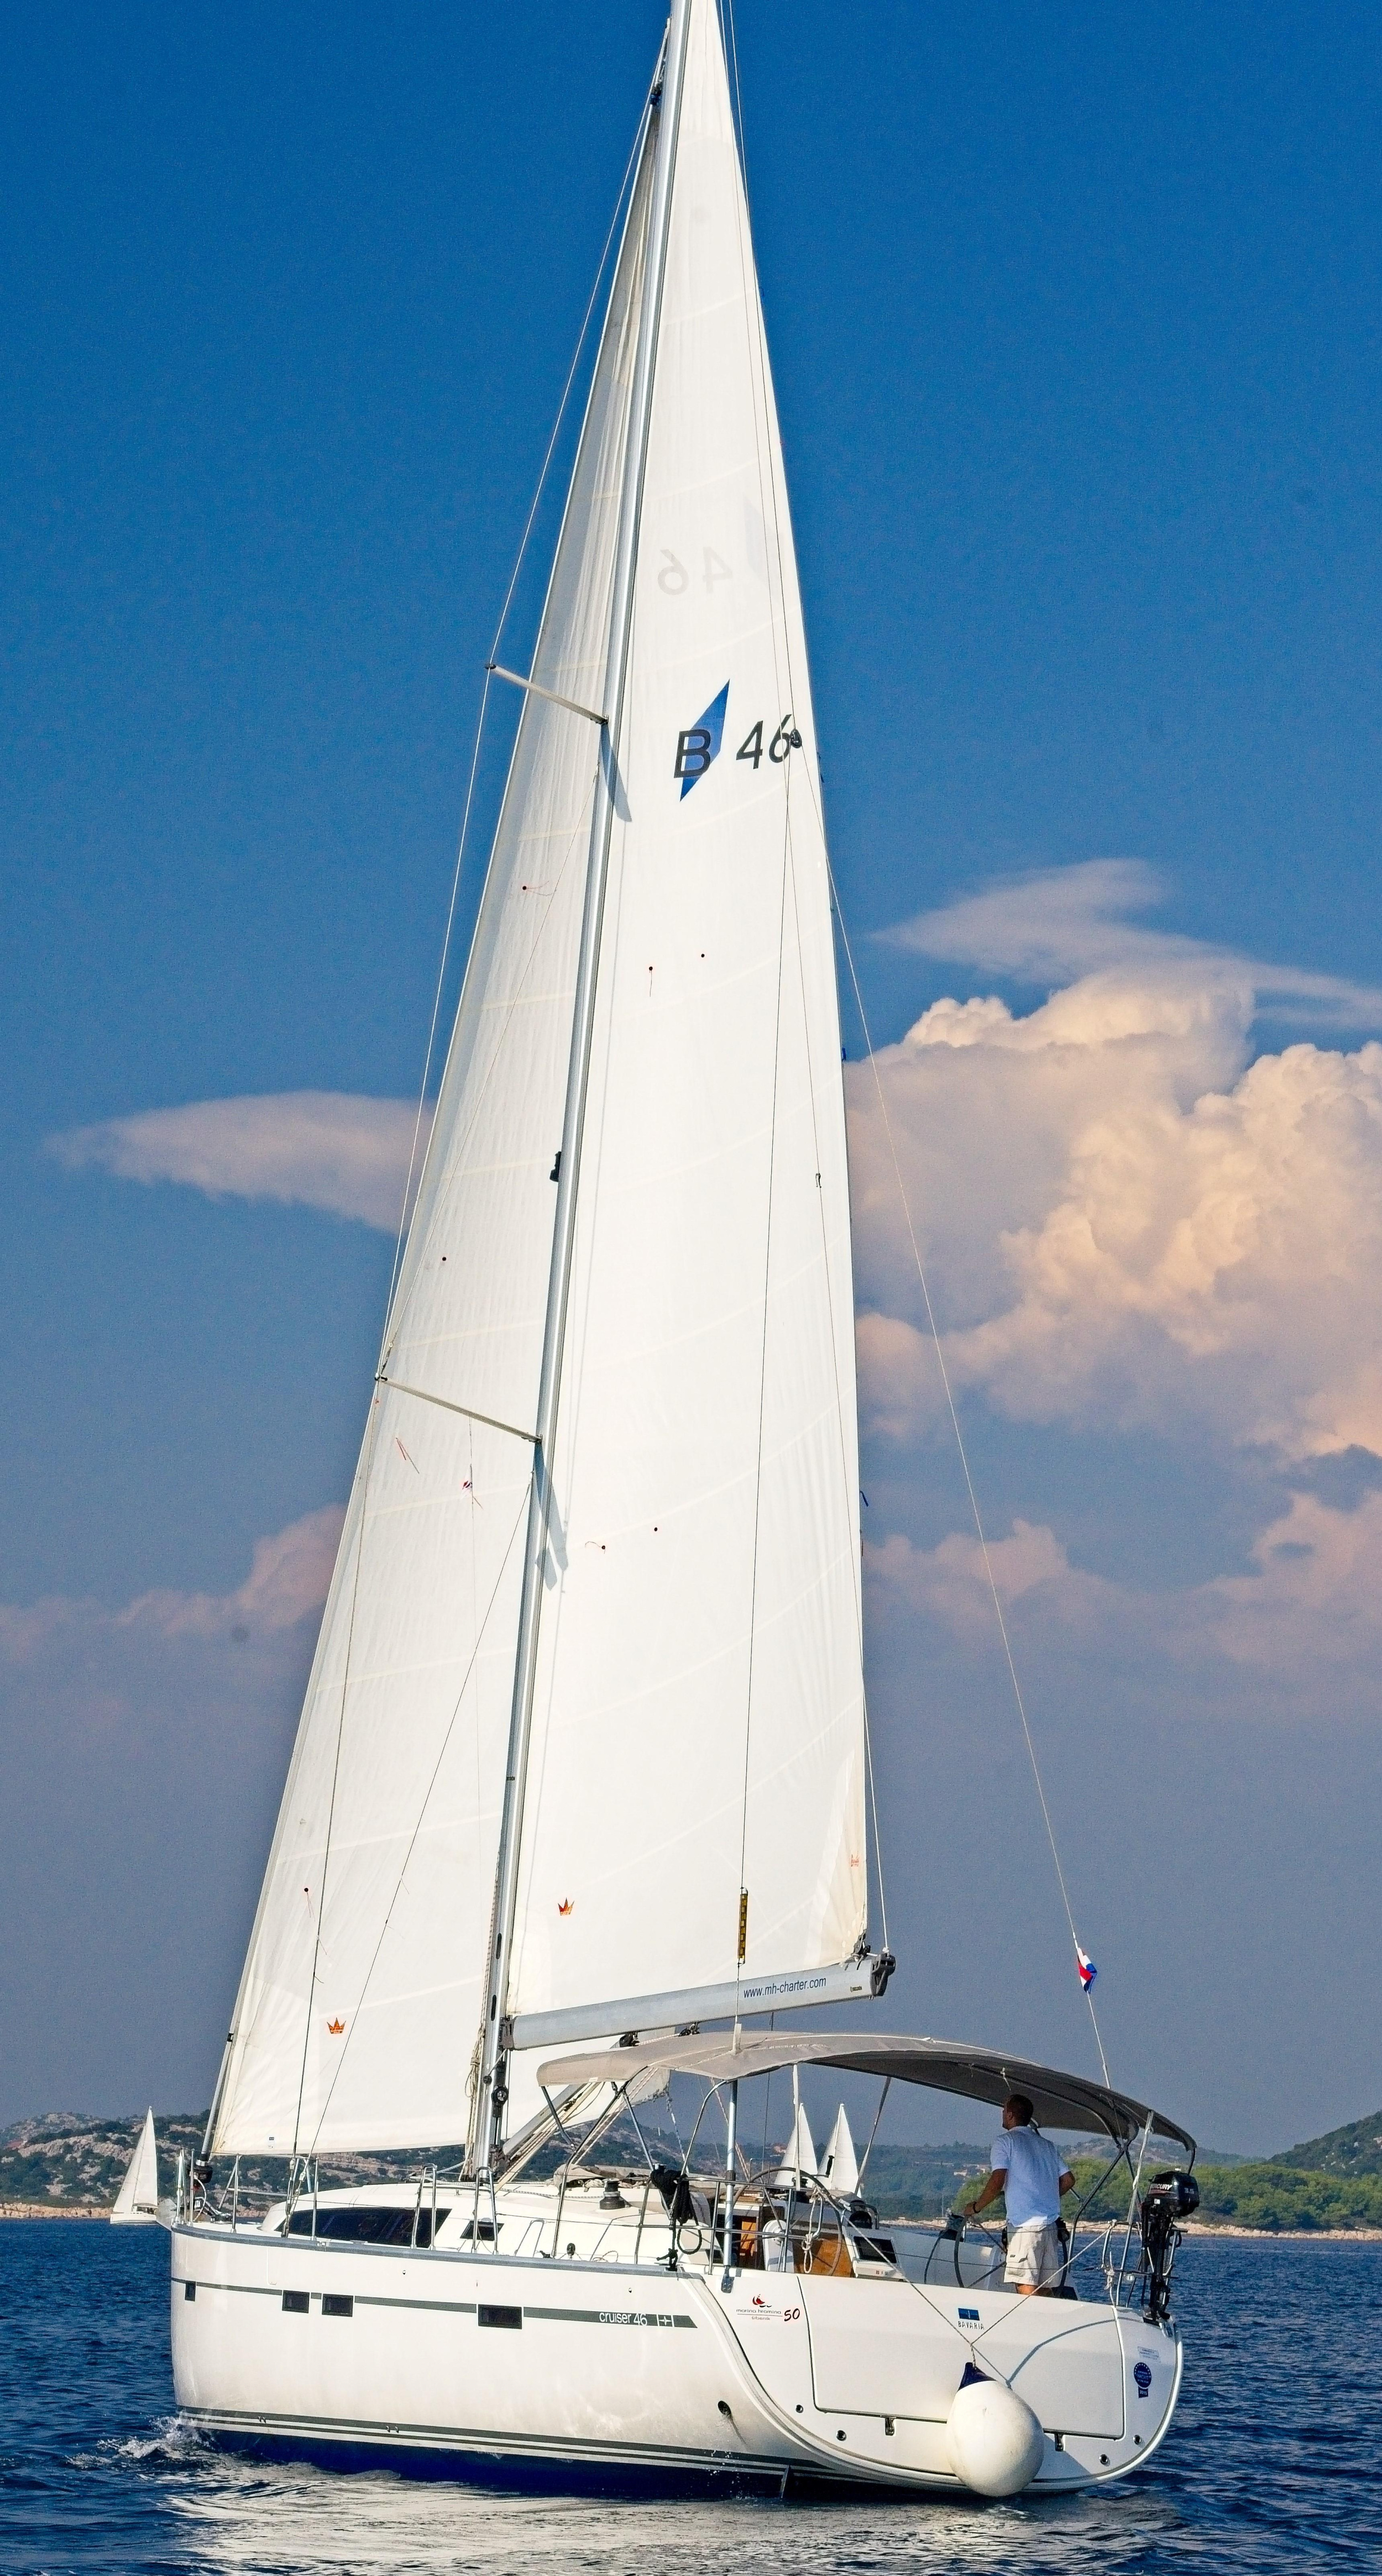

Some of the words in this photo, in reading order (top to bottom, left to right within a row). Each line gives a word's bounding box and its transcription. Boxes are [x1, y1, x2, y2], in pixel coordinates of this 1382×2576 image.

[674, 728, 711, 778] B
[736, 714, 792, 769] 46
[744, 1977, 826, 1998] www.mh-charter.com
[599, 2312, 632, 2323] cruiser
[633, 2313, 648, 2326] 46
[784, 2308, 800, 2322] 50
[958, 2321, 985, 2330] BAVARIA
